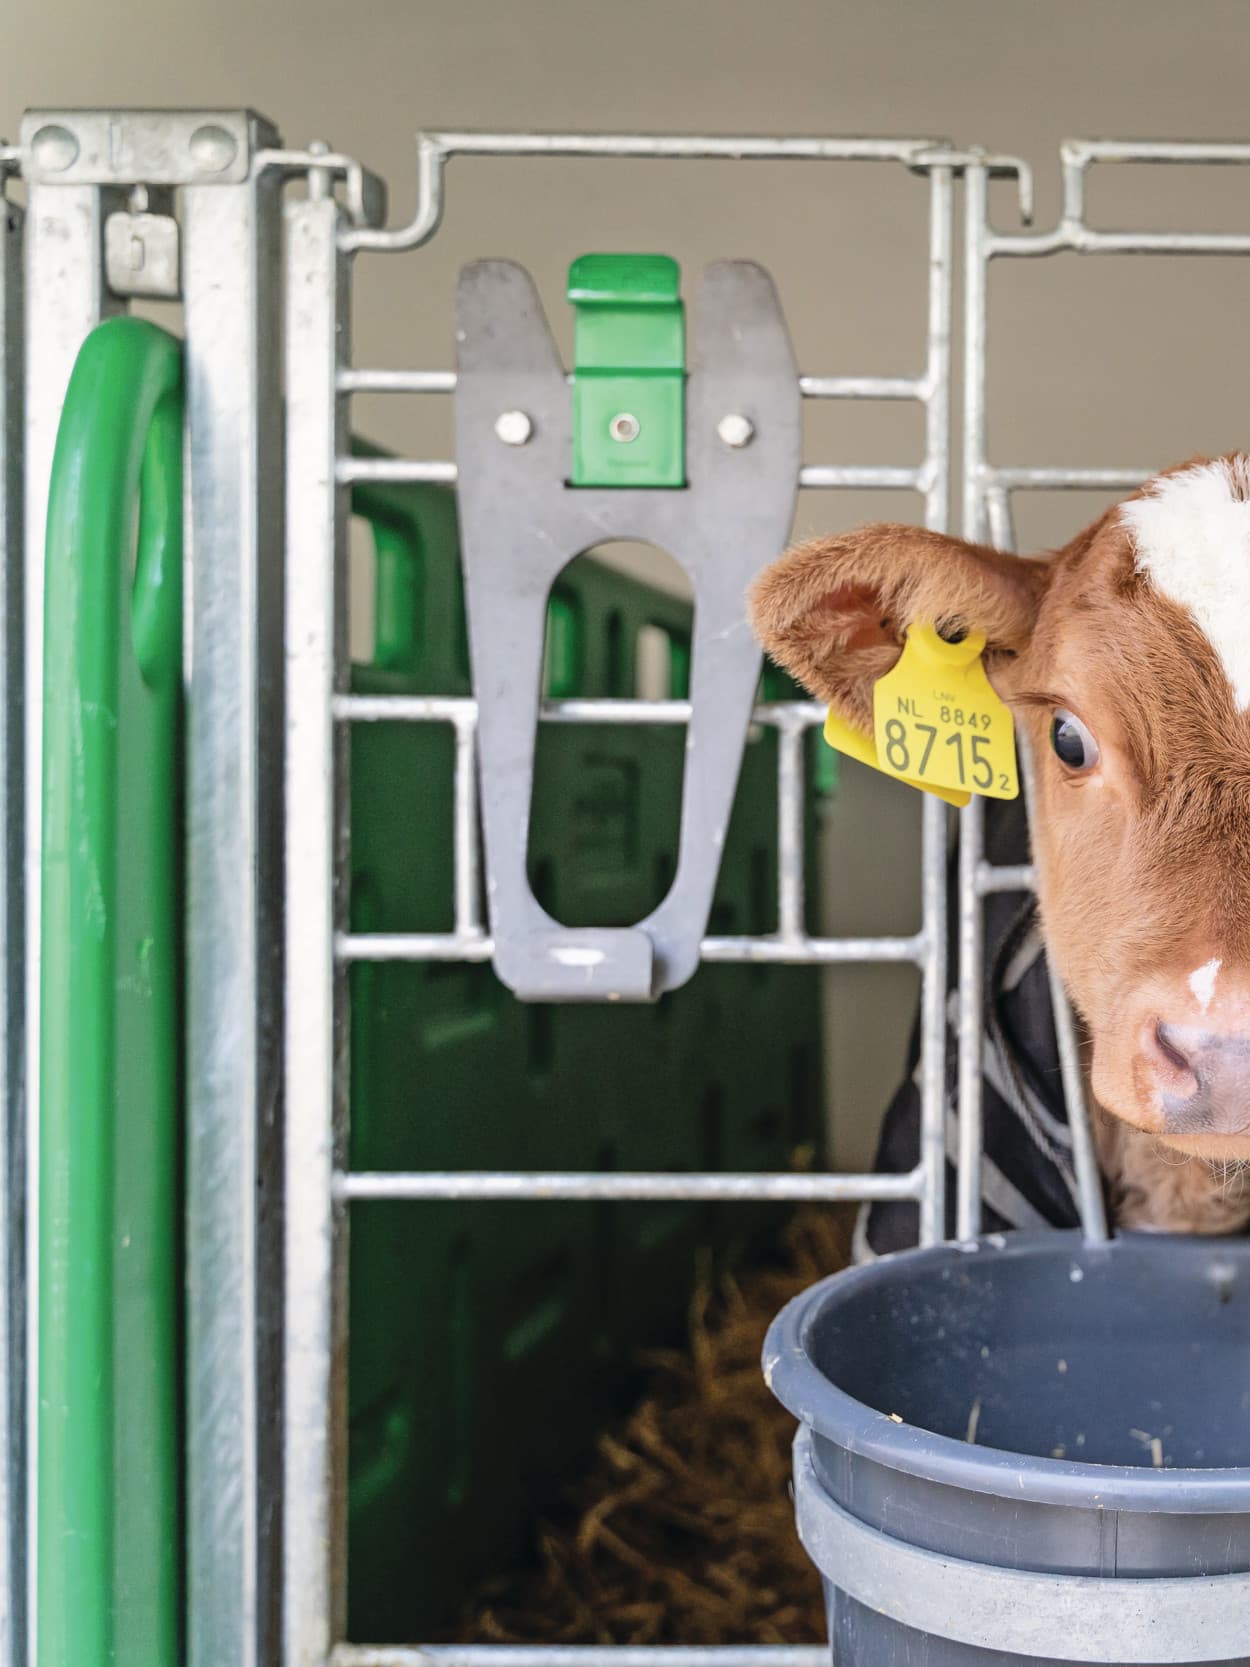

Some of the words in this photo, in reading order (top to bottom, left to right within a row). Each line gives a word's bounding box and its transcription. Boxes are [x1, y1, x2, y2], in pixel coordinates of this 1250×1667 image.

[897, 696, 923, 718] NL
[940, 705, 992, 731] 8849
[885, 718, 993, 789] 8715
